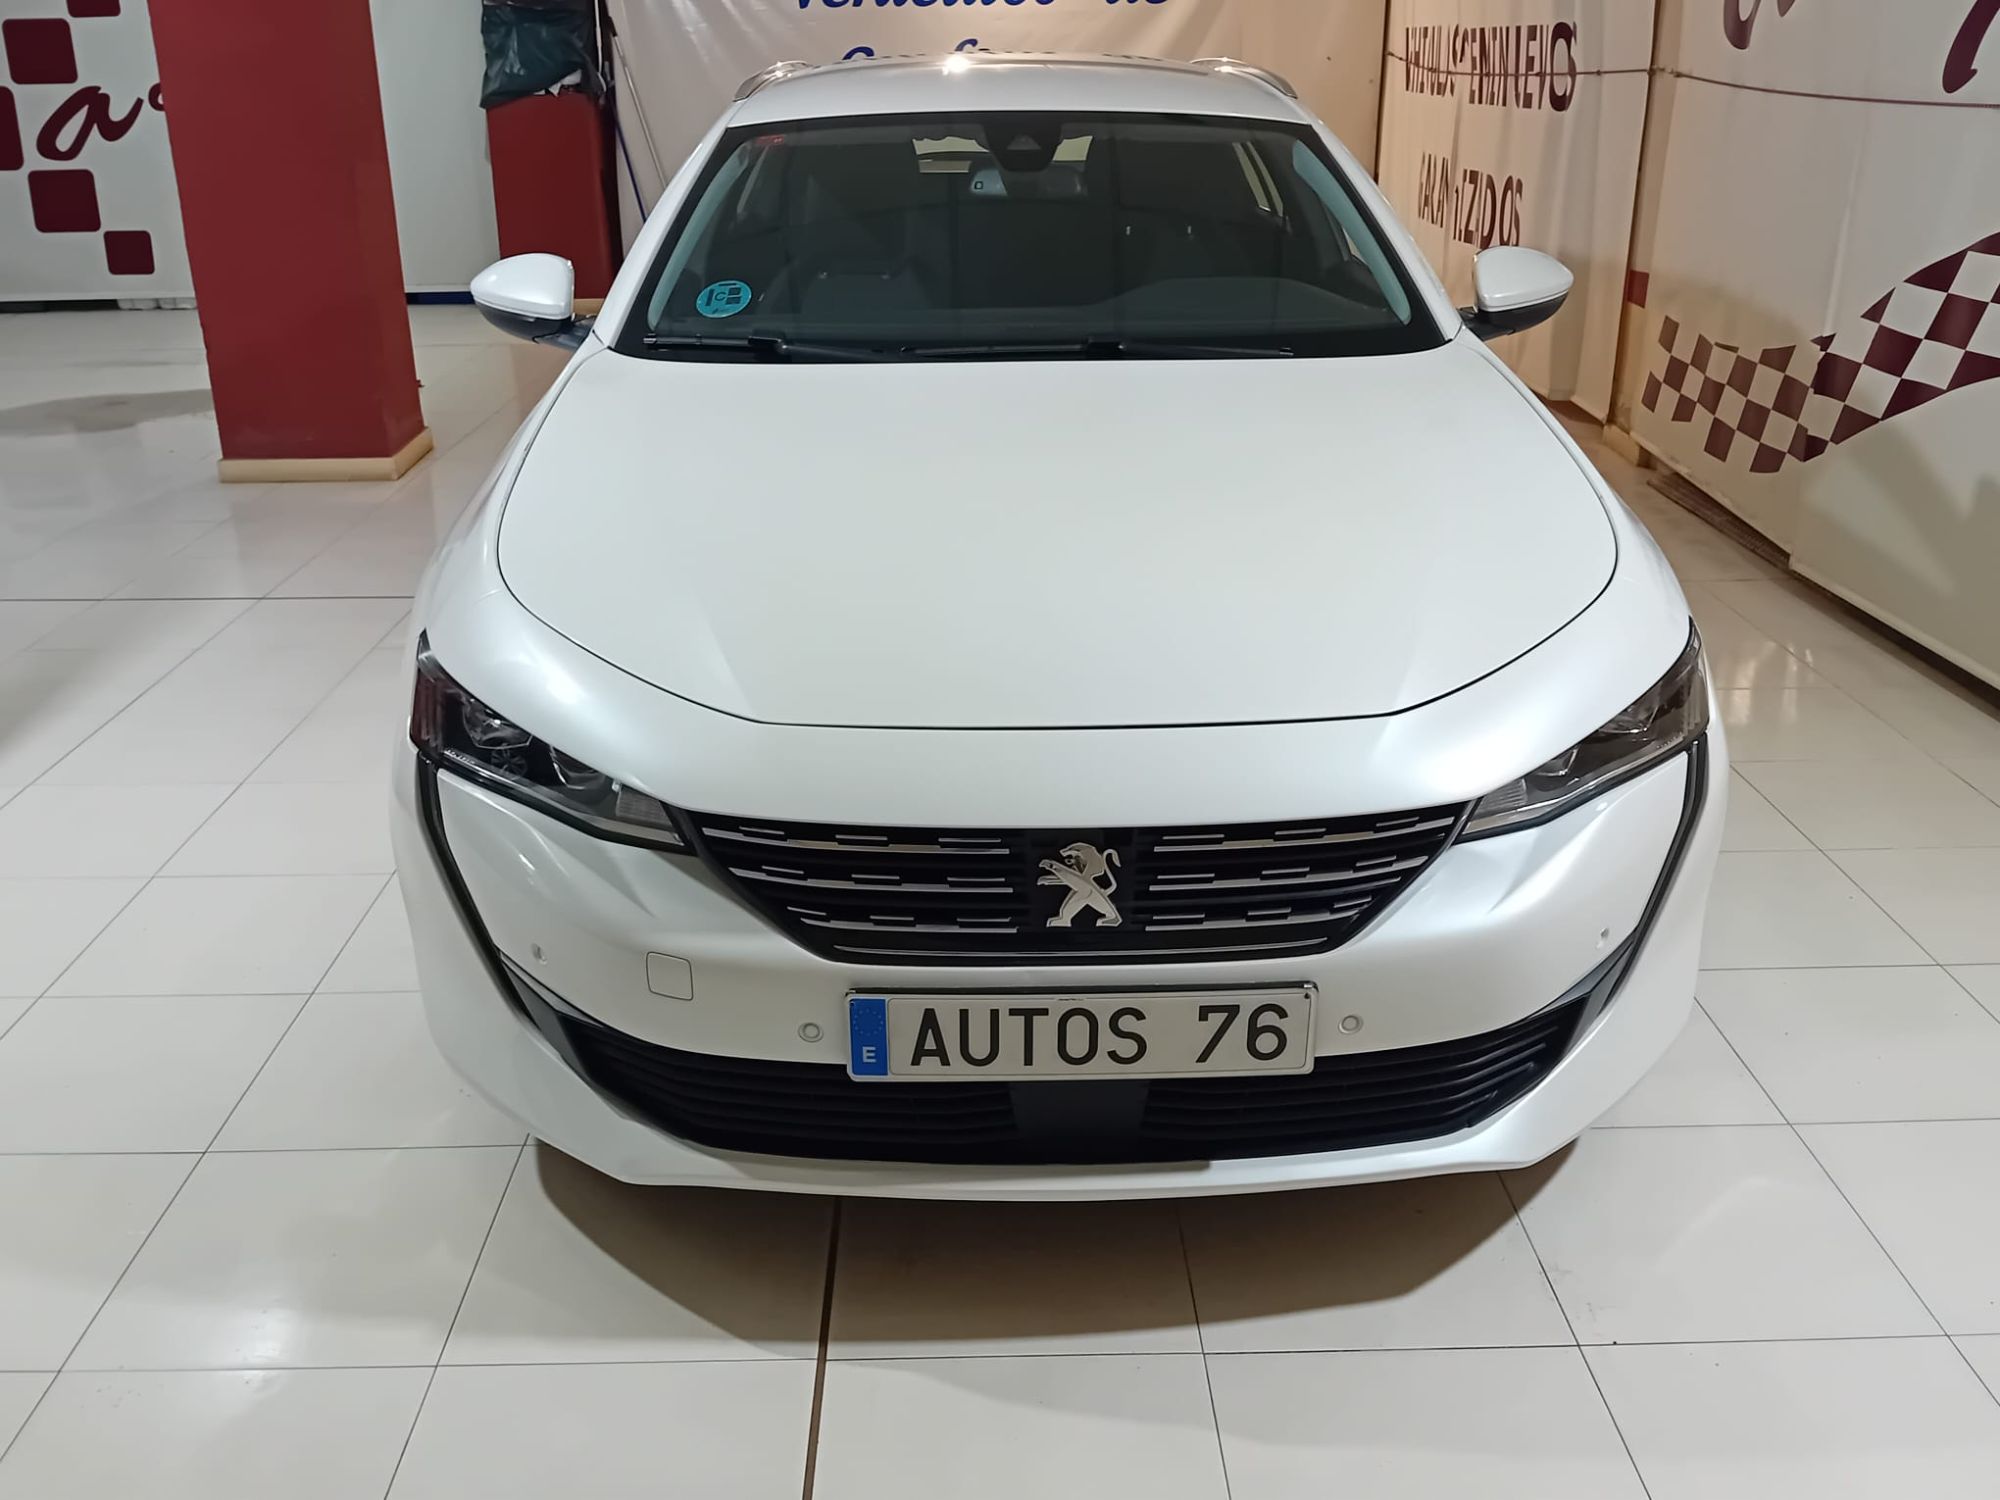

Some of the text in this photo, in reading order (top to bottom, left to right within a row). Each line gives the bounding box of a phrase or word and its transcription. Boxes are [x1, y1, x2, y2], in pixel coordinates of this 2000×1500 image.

[862, 1046, 877, 1063] E
[910, 1003, 1288, 1067] AUTOS 76
